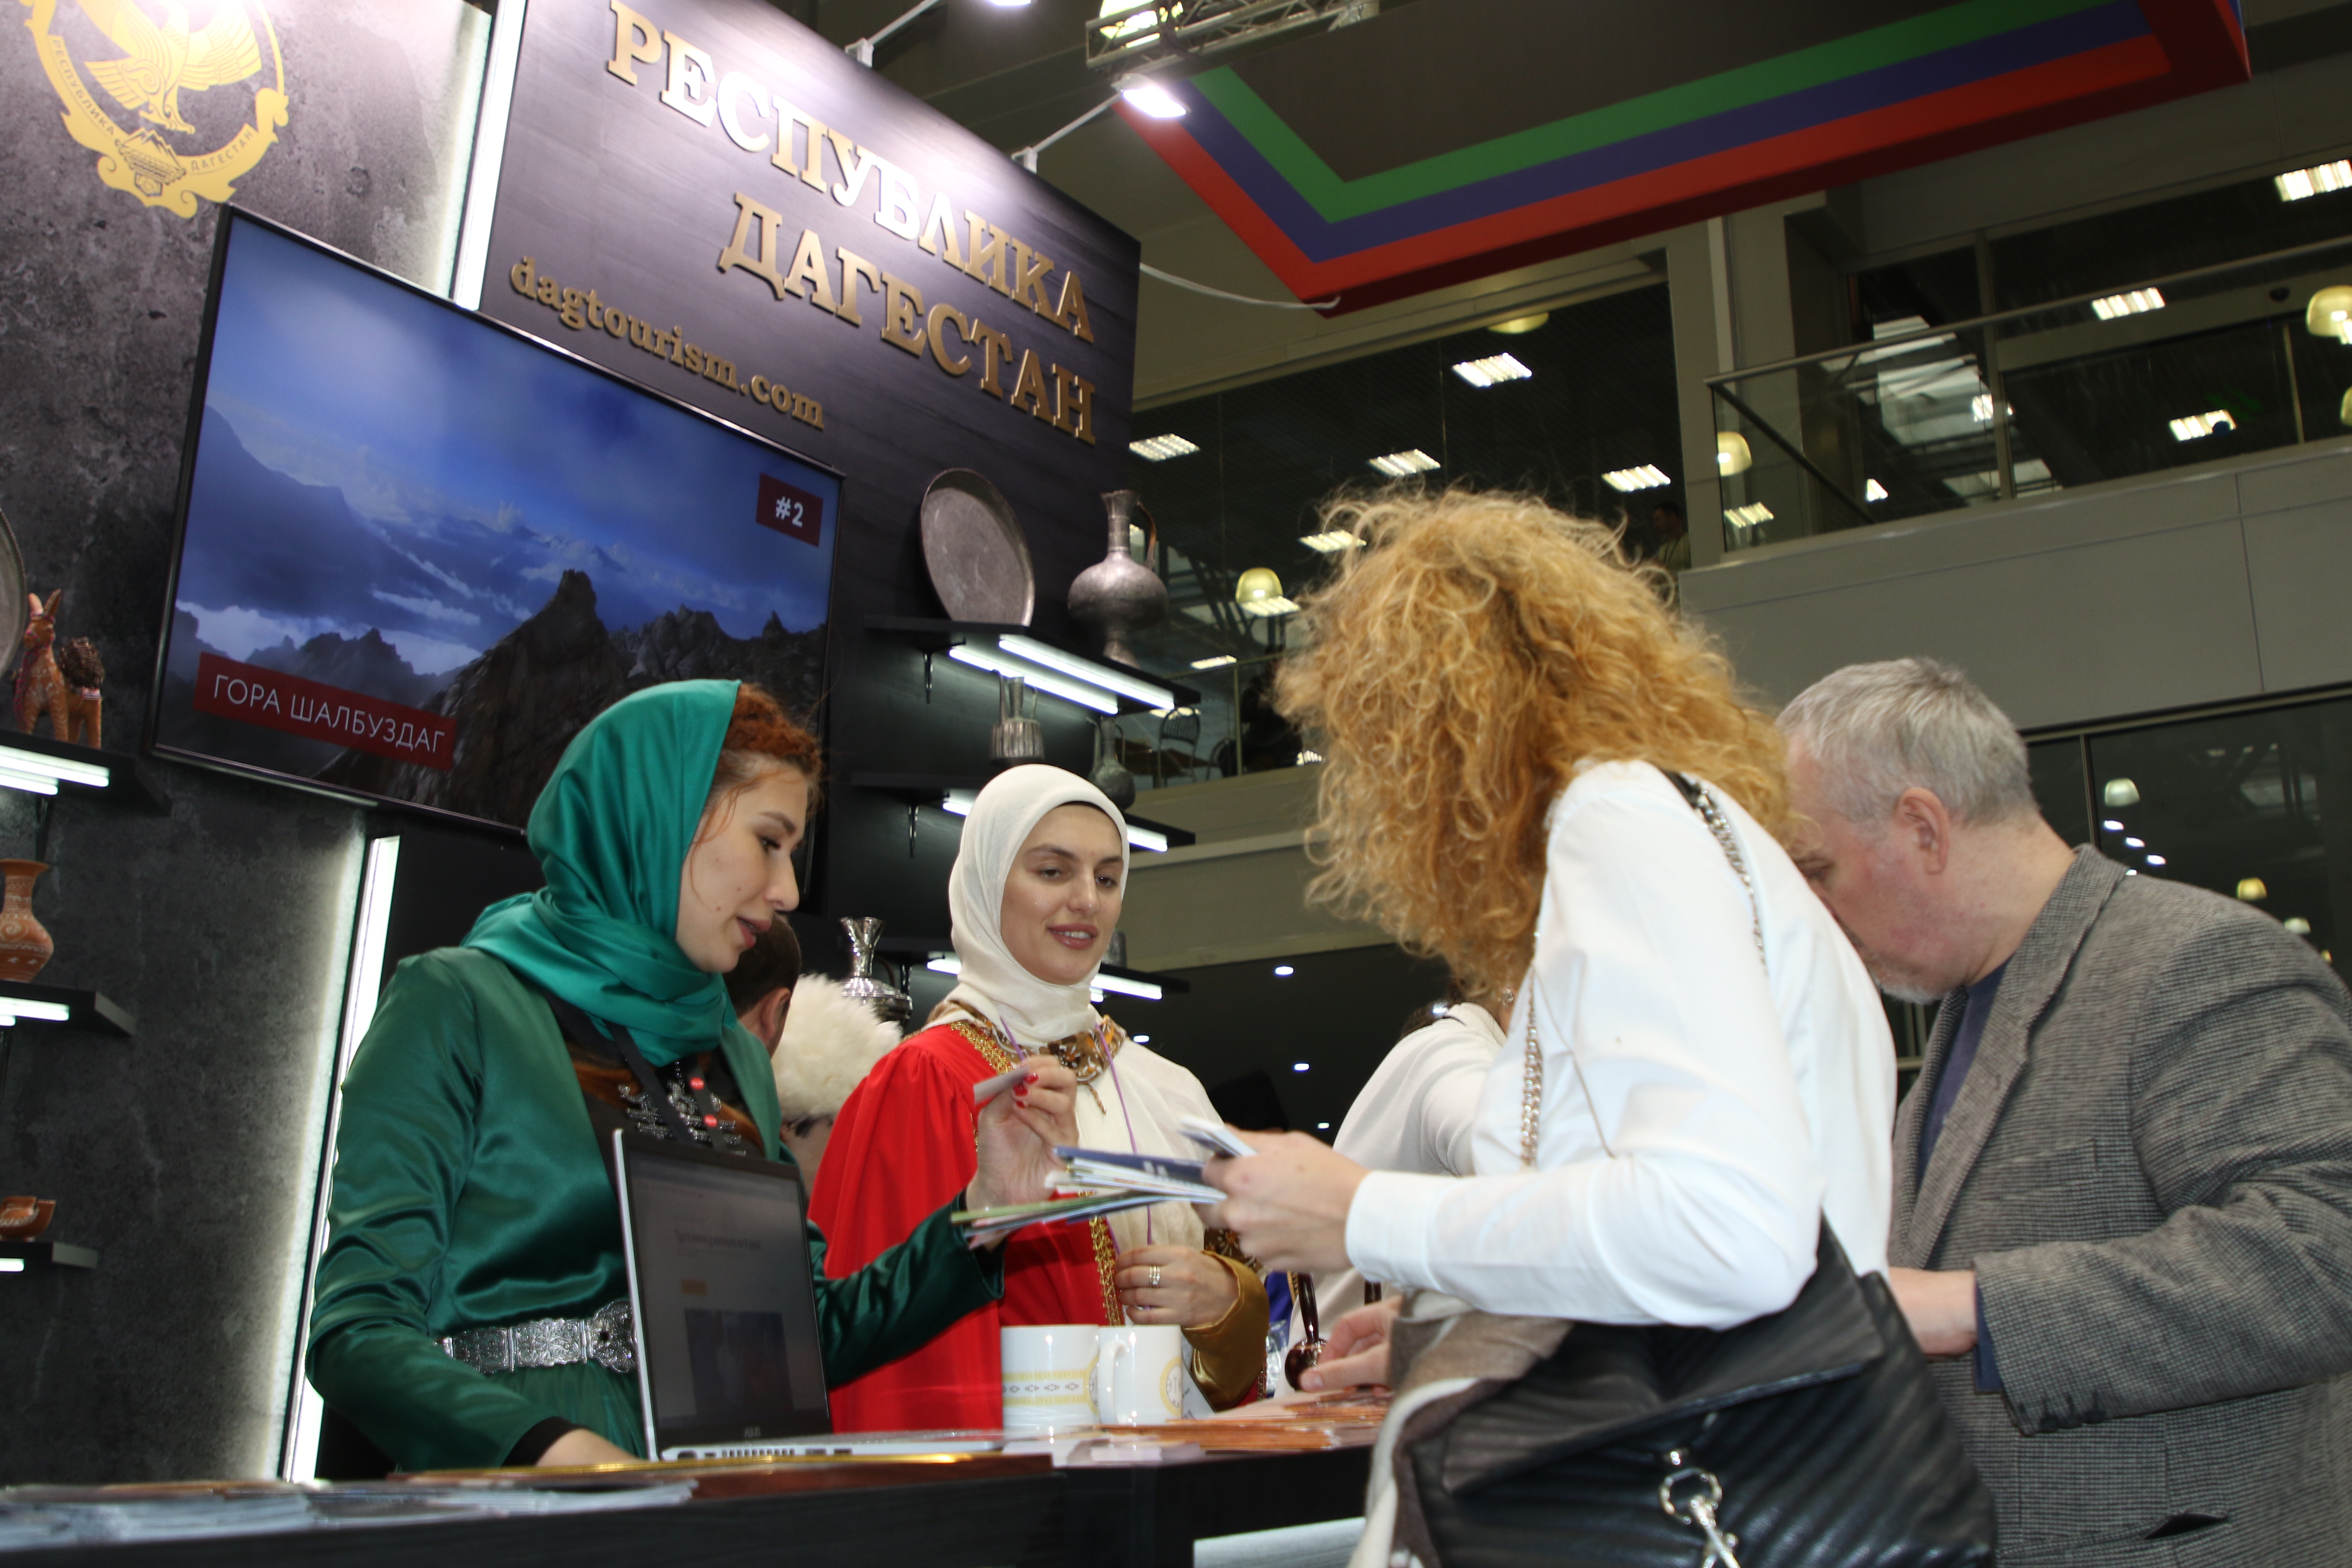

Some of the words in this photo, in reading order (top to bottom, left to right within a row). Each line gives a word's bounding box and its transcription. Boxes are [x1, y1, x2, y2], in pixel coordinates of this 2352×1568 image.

[53, 40, 115, 135] РЕСПУБЛИКА
[191, 130, 254, 171] ДАГЕСТАН
[606, 3, 1095, 343] РЕСПУБЛИКА
[510, 256, 824, 430] dagtourism.com
[718, 192, 1096, 446] ДАГЕСТАН
[775, 496, 803, 528] #2
[214, 674, 280, 714] ГОРА
[291, 694, 445, 753] ШАЛБУЗДАГ
